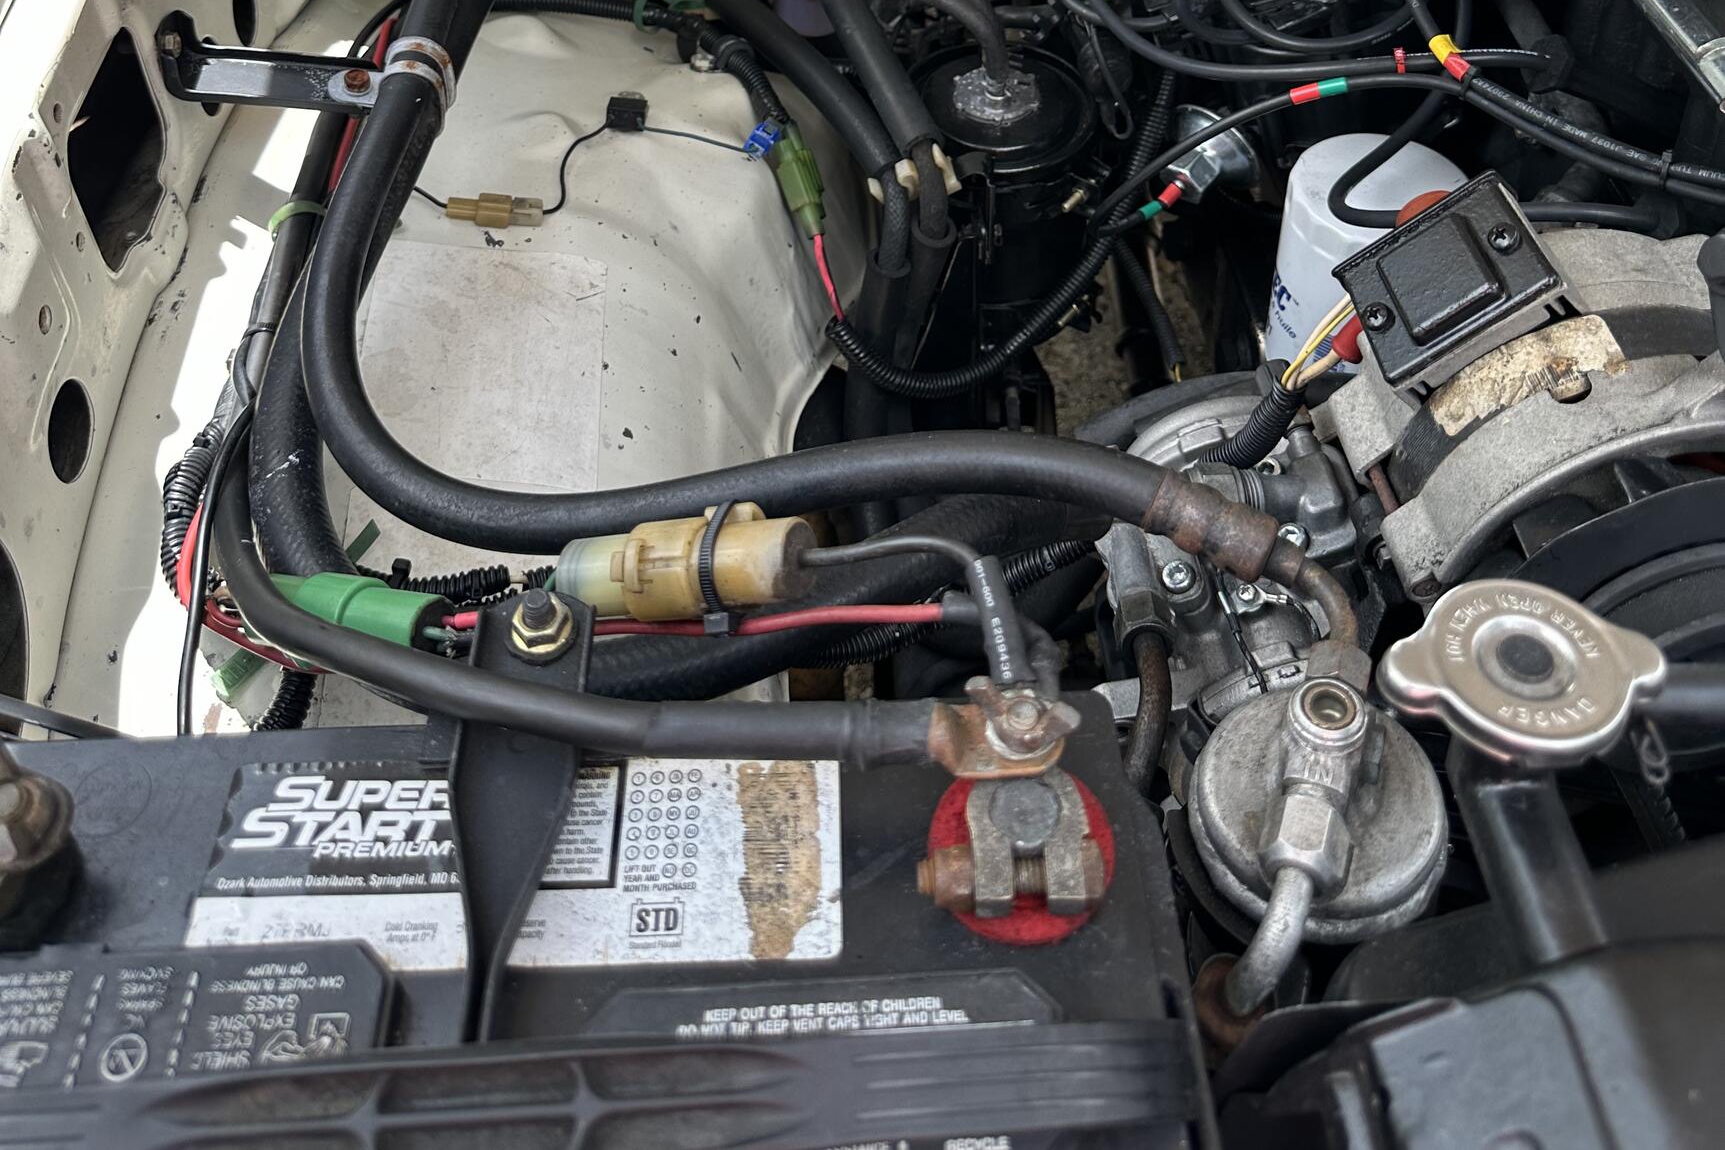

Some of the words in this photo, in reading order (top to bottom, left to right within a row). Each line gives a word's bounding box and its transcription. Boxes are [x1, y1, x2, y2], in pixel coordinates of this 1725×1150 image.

[1515, 99, 1544, 120] CHINA
[1544, 115, 1559, 126] IN
[1561, 122, 1588, 138] MADE
[1496, 593, 1546, 616] OPEN
[1451, 598, 1492, 633] WHEN
[1551, 610, 1600, 658] NEVER
[991, 616, 1013, 680] E209436
[1446, 634, 1465, 662] HOT
[1498, 698, 1598, 727] DANGER
[1304, 752, 1334, 786] IN
[266, 775, 450, 811] SUPER
[230, 807, 453, 849] START
[313, 839, 453, 859] PREMIUM
[623, 874, 643, 883] YEAR
[644, 873, 660, 882] AND
[624, 864, 640, 873] LIFT
[641, 863, 657, 873] OUT
[217, 877, 245, 889] Ozark
[247, 875, 303, 888] Automotive
[430, 872, 448, 884] MO
[623, 883, 650, 893] MONTH
[652, 881, 697, 891] PURCHASED
[636, 907, 679, 932] STD
[278, 976, 317, 991] CAUSE
[320, 975, 345, 990] CAN
[243, 994, 300, 1012] GASES
[704, 1008, 737, 1022] KEEP
[740, 1006, 767, 1020] OUT
[769, 1004, 787, 1018] OF
[790, 1002, 815, 1017] THE
[818, 1001, 858, 1015] REACH
[861, 999, 880, 1013] OF
[881, 996, 942, 1011] CHILDREN
[207, 1012, 297, 1032] EXPLOSIVE
[701, 1023, 727, 1038] NOT
[758, 1018, 790, 1034] KEEP
[793, 1016, 825, 1032] VENT
[828, 1015, 860, 1029] CAPS
[903, 1010, 929, 1025] AND
[212, 1031, 256, 1049] EYES
